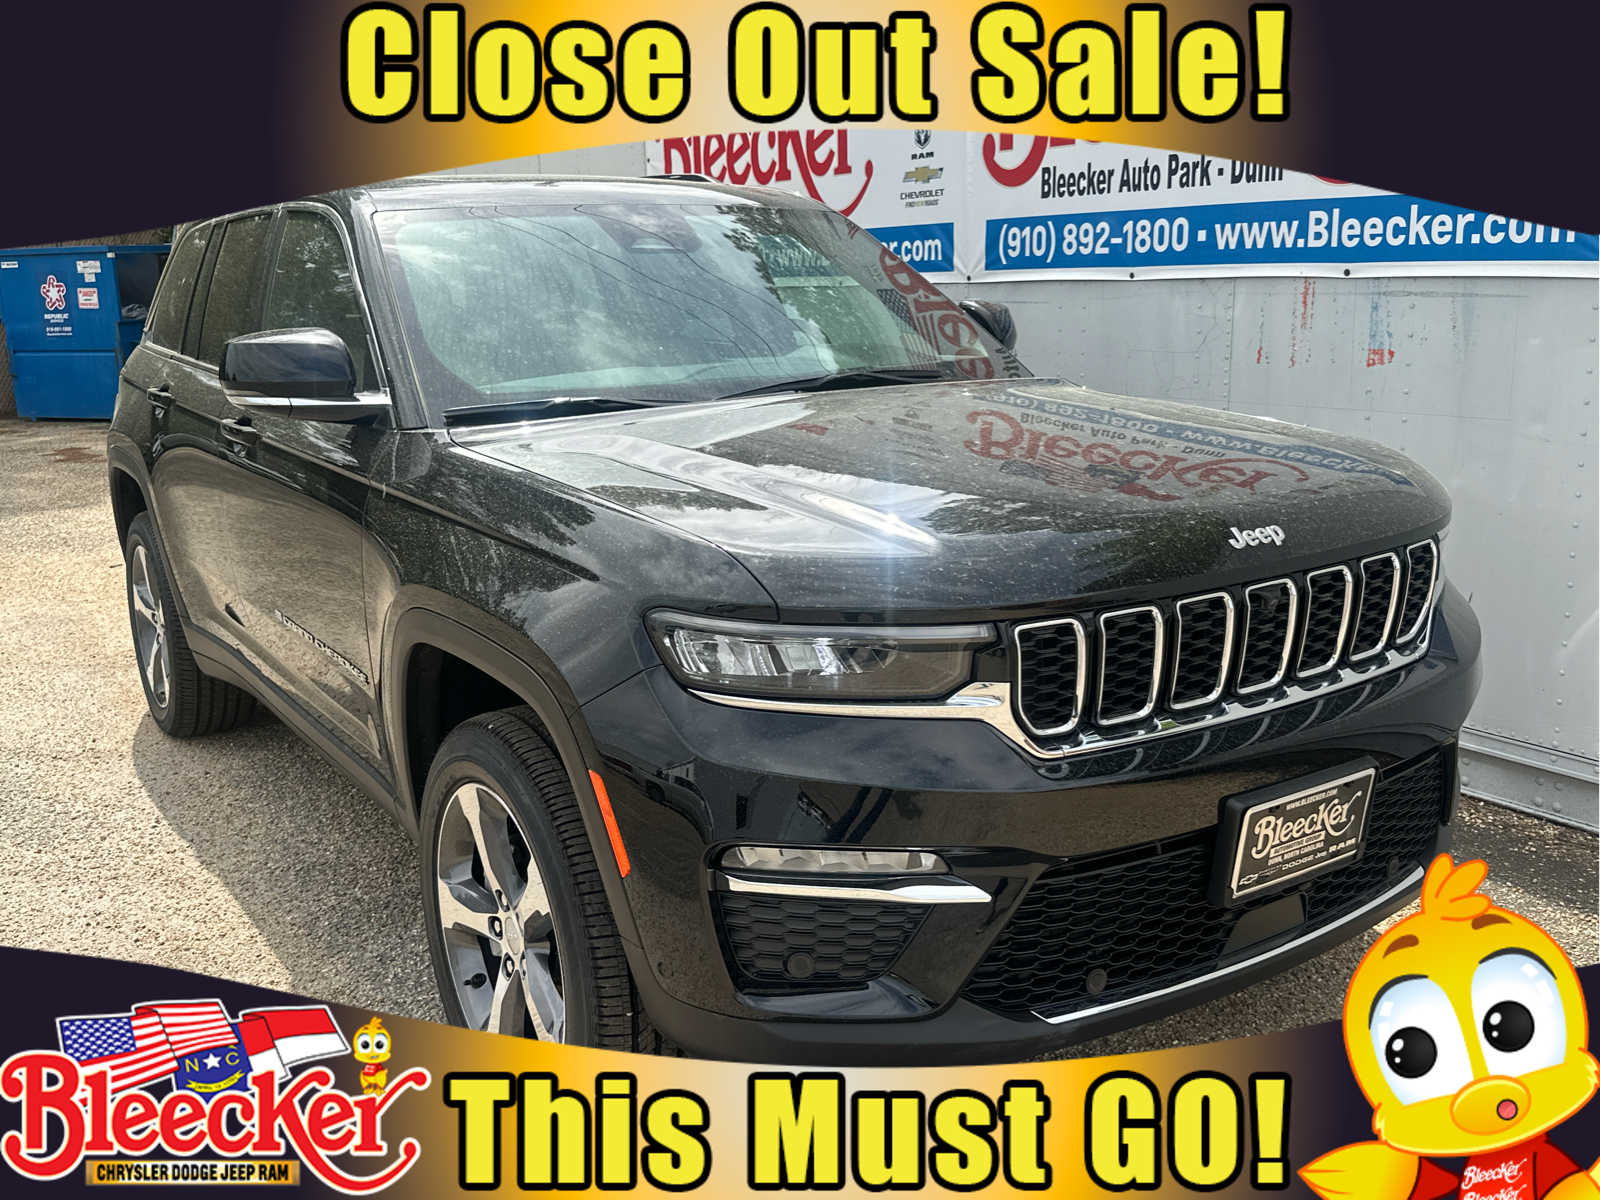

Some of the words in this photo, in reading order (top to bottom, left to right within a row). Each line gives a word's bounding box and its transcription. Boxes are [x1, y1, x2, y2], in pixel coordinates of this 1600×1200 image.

[911, 151, 935, 160] RAM
[1041, 162, 1115, 199] Bleecker
[1118, 158, 1161, 193] Auto
[1167, 153, 1212, 189] Park
[900, 188, 945, 200] CHEVROLET
[998, 221, 1056, 264] (910)
[1061, 217, 1189, 256] 892-1800
[1228, 525, 1285, 549] Jeep
[1251, 790, 1362, 859] Bleecker
[1329, 838, 1356, 853] RAM
